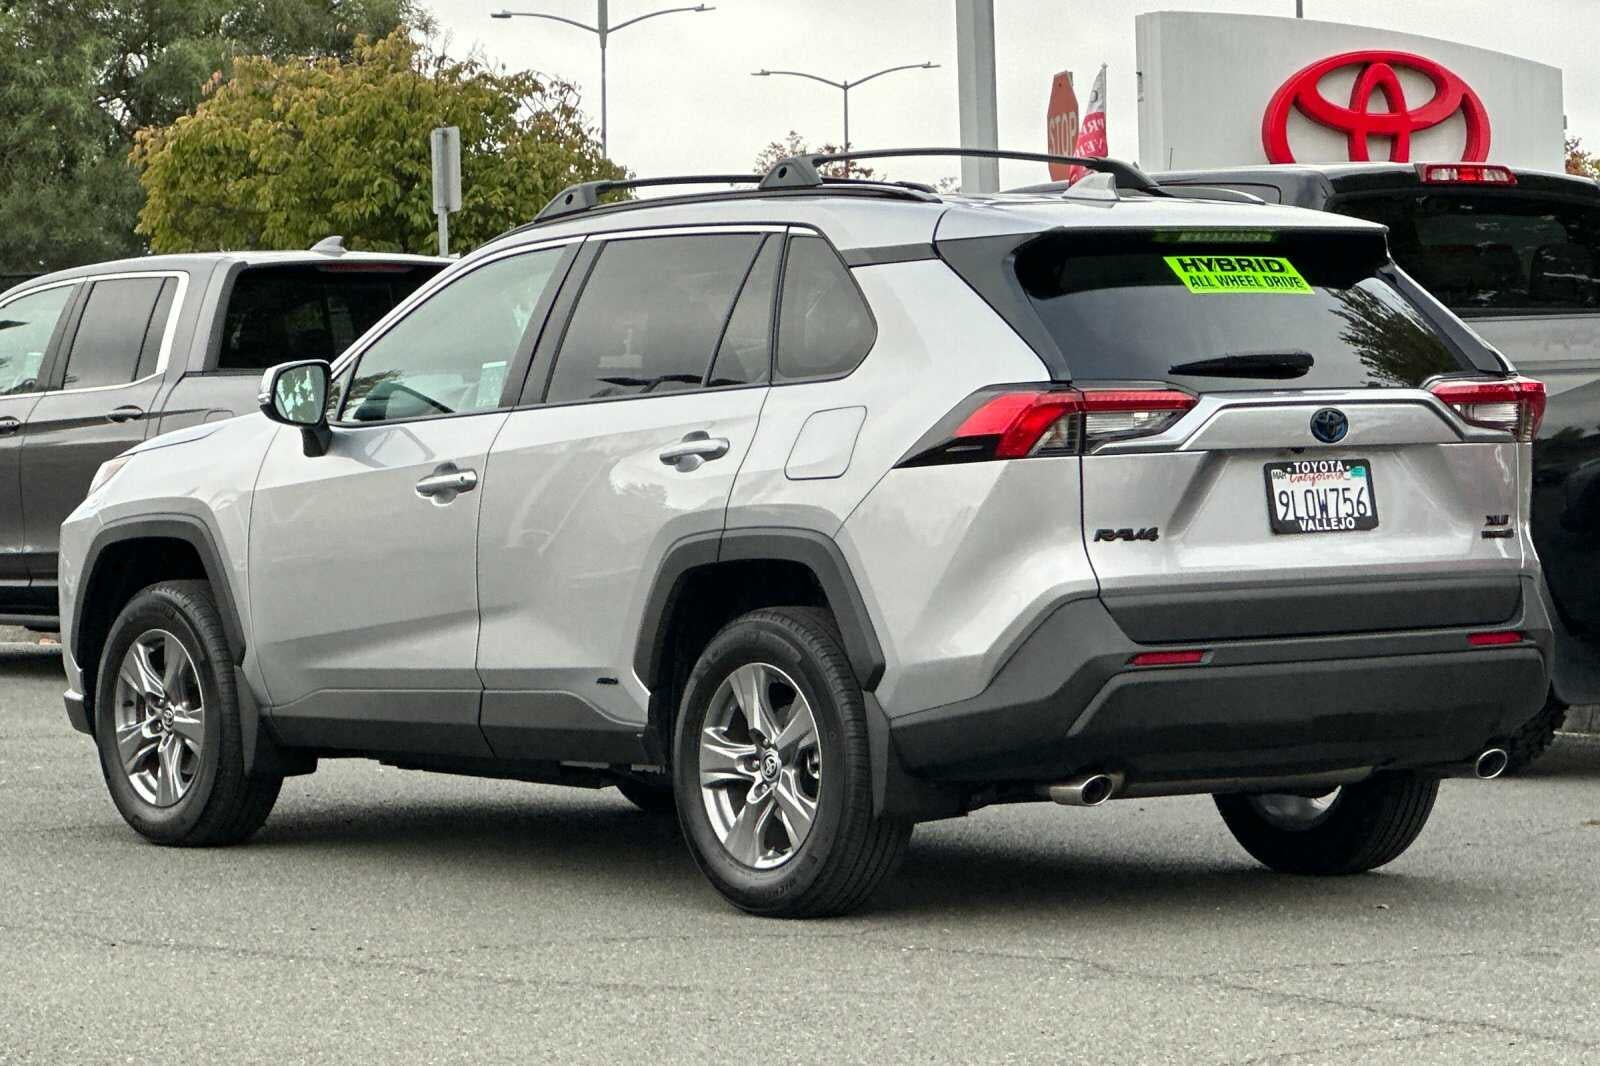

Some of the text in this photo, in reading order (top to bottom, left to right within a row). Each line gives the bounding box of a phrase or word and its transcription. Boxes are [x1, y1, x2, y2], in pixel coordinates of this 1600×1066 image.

[1048, 111, 1077, 158] STOP
[1176, 257, 1288, 273] HYBRID
[1189, 275, 1304, 289] ALL WHEEL DRIVE
[1293, 460, 1344, 474] TOYOTA
[1299, 516, 1356, 532] VALLEJO
[1094, 527, 1159, 542] RAV4
